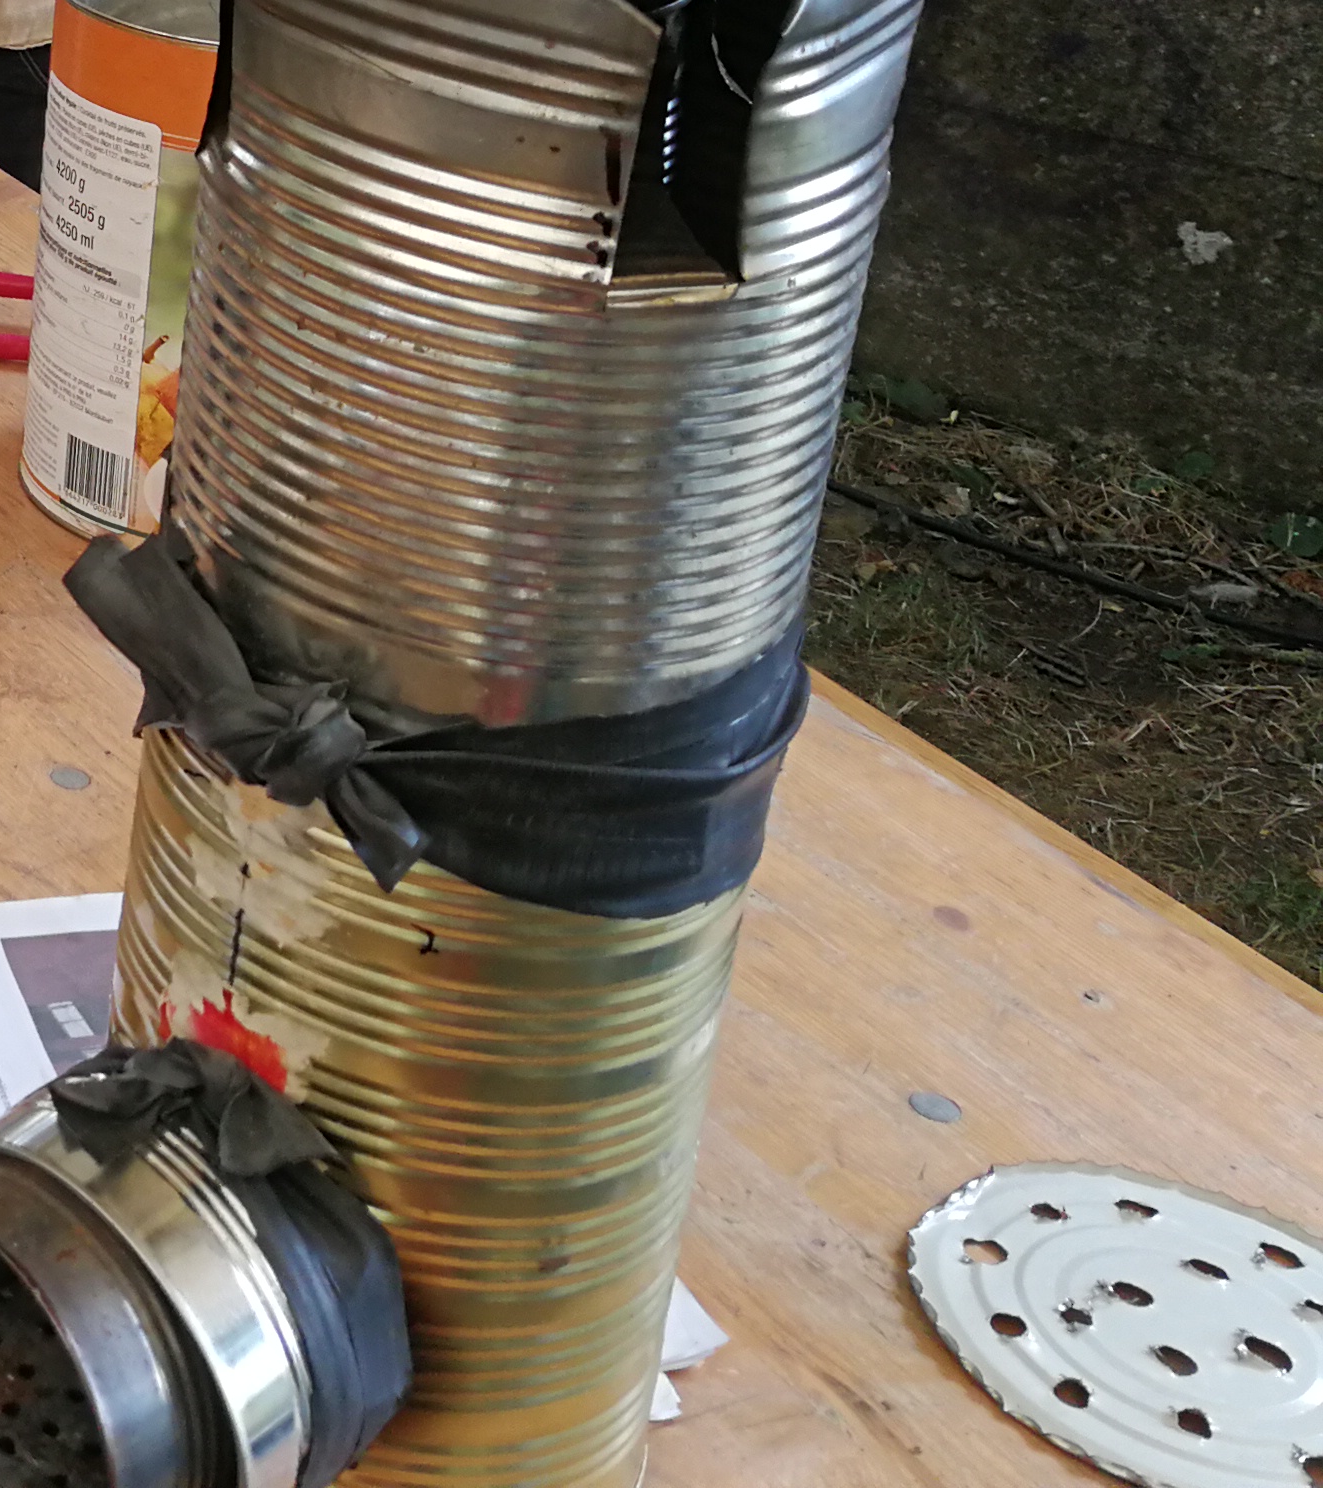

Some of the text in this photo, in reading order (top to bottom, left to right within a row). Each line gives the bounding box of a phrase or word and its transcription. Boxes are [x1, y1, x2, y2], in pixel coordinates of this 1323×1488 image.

[124, 138, 140, 149] cubes
[56, 158, 77, 185] 4200
[78, 178, 86, 193] g
[68, 195, 94, 223] 2505
[97, 215, 106, 230] g
[55, 214, 78, 241] 4250
[80, 233, 94, 250] ml
